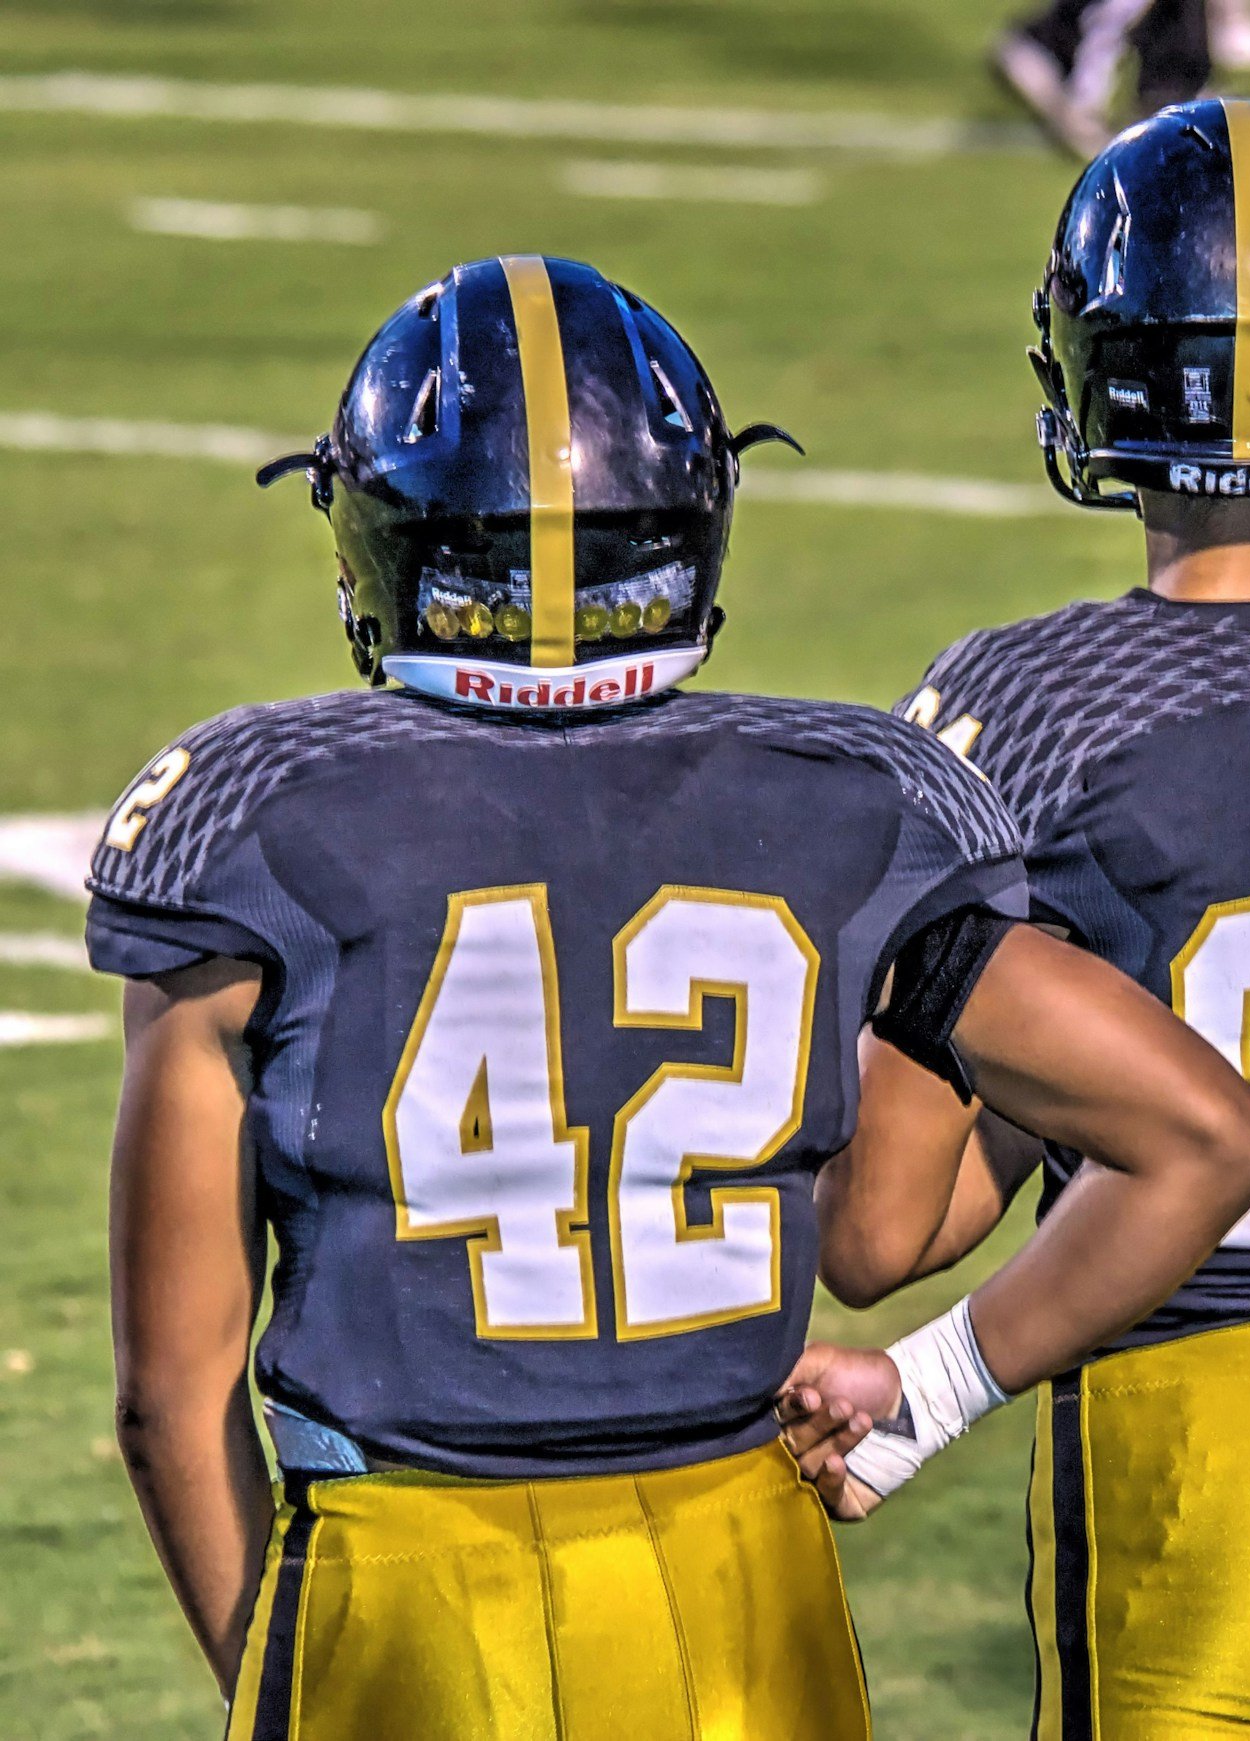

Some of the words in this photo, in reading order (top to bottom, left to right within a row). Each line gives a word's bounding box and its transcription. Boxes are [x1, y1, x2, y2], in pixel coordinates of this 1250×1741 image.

[1108, 386, 1147, 409] Riddell
[455, 661, 655, 708] Riddell
[106, 747, 191, 852] 2
[382, 882, 821, 1342] 42
